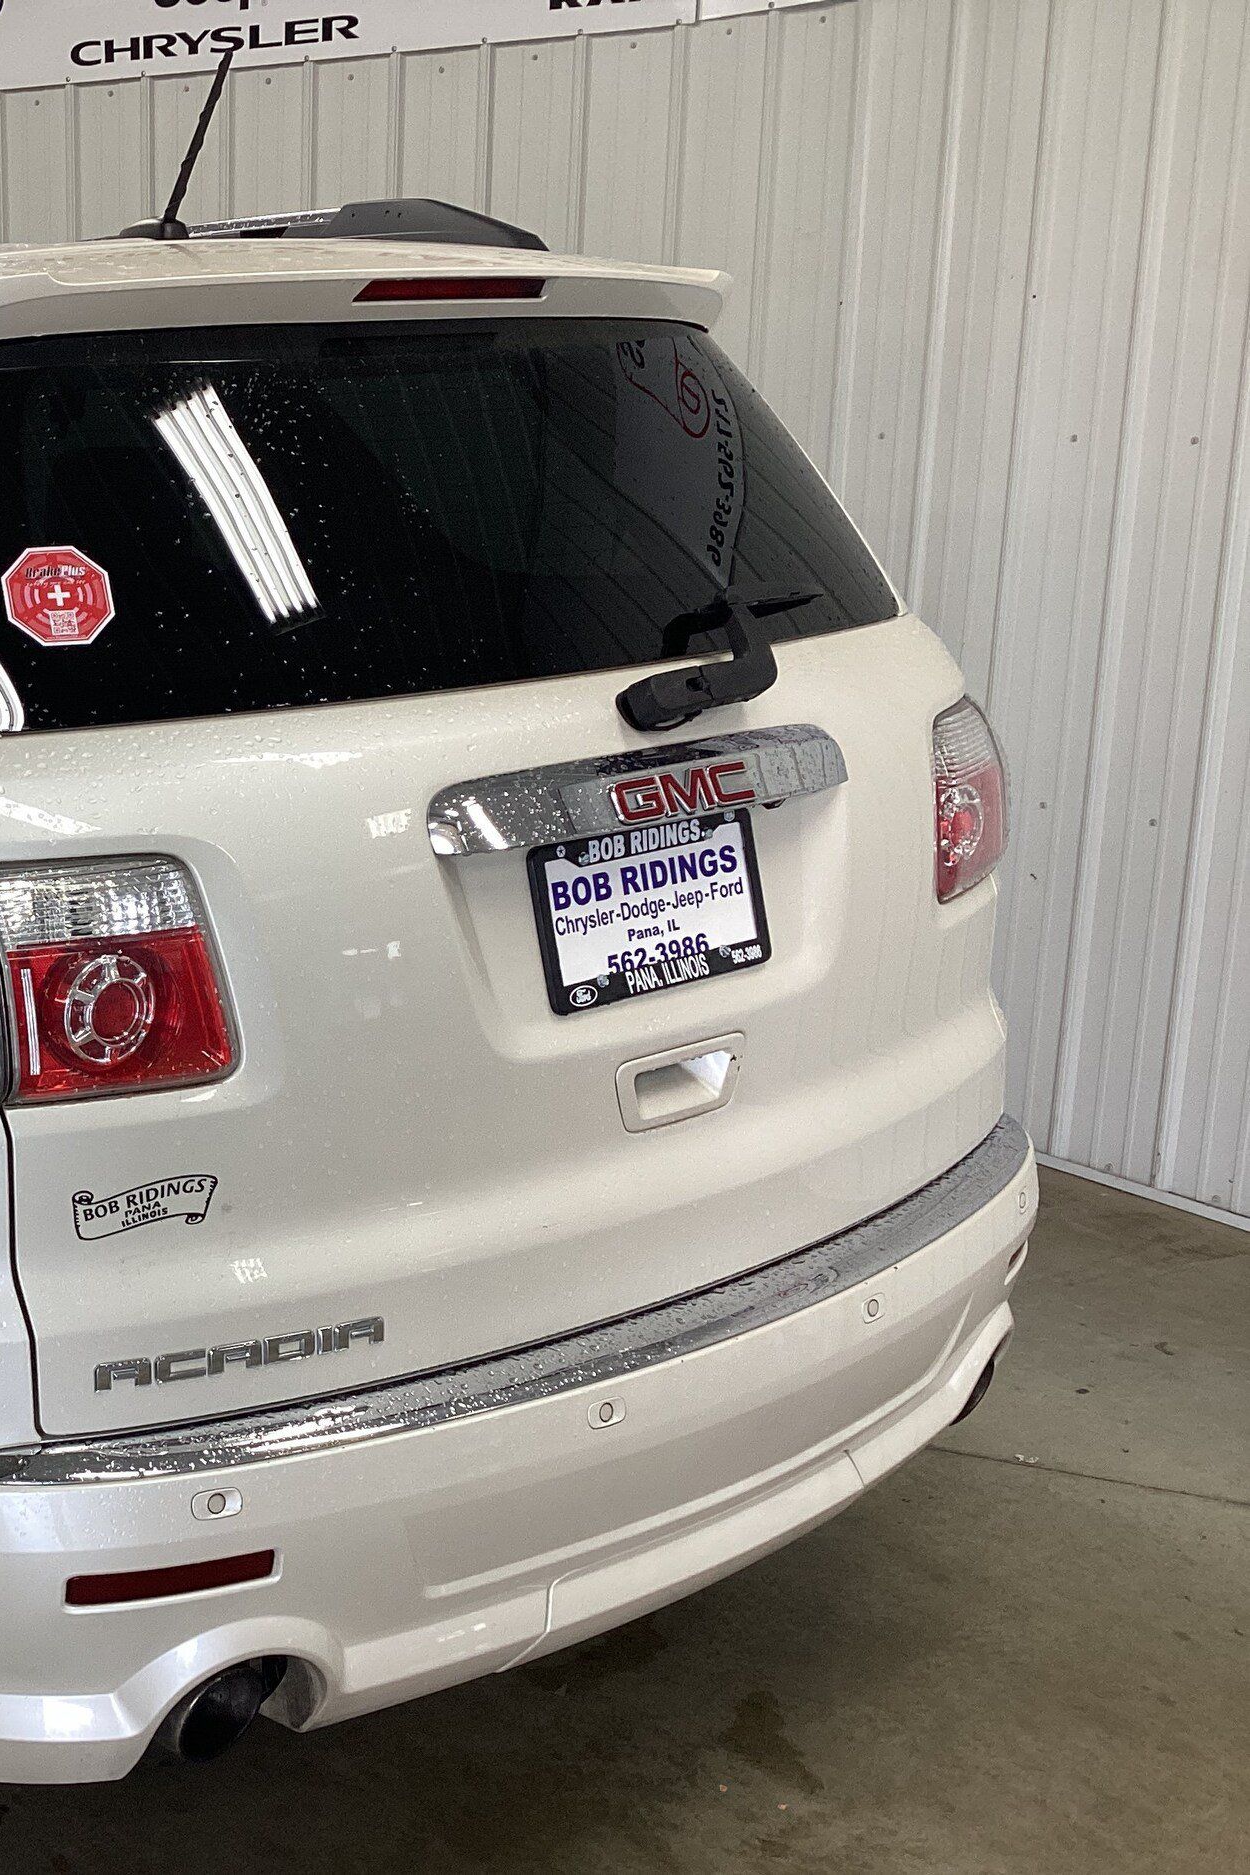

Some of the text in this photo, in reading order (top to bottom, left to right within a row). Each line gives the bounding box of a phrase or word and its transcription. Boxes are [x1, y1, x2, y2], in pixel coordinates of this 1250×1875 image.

[70, 15, 360, 66] CHRYSLER
[609, 760, 756, 825] GMC
[588, 818, 701, 863] BOB RIDINGS
[551, 845, 737, 911] BOB RIDINGS
[555, 876, 743, 936] Chrysler-Dodge-Jeep-Ford
[627, 919, 680, 942] Pana, IL
[607, 933, 710, 975] 562-3986
[661, 953, 710, 985] ILLINOIS
[83, 1178, 207, 1222] BOB RIDINGS
[121, 1207, 168, 1228] ILLINOIS
[124, 1200, 162, 1218] PANA
[94, 1316, 385, 1393] ACADIA
